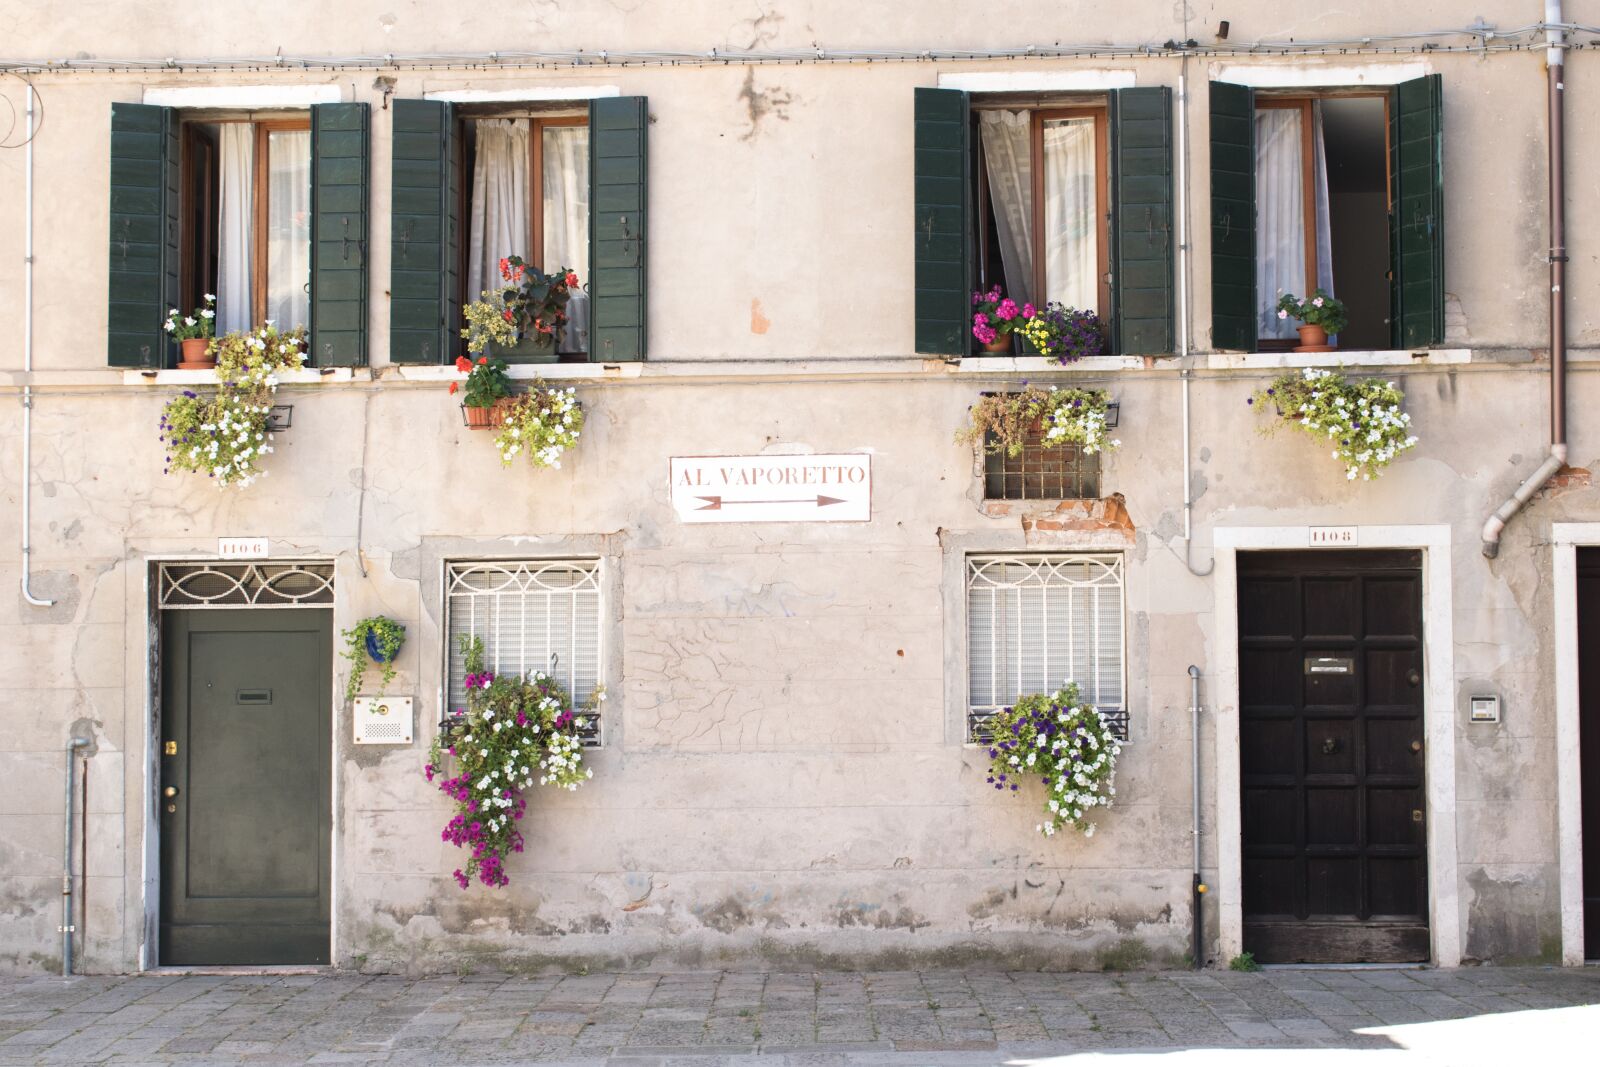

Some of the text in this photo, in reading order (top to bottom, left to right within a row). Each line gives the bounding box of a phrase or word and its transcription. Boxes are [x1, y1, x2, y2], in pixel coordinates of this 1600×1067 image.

[679, 465, 865, 486] AL VAPORETTO
[1313, 531, 1351, 542] 1108
[223, 543, 262, 554] 1106
